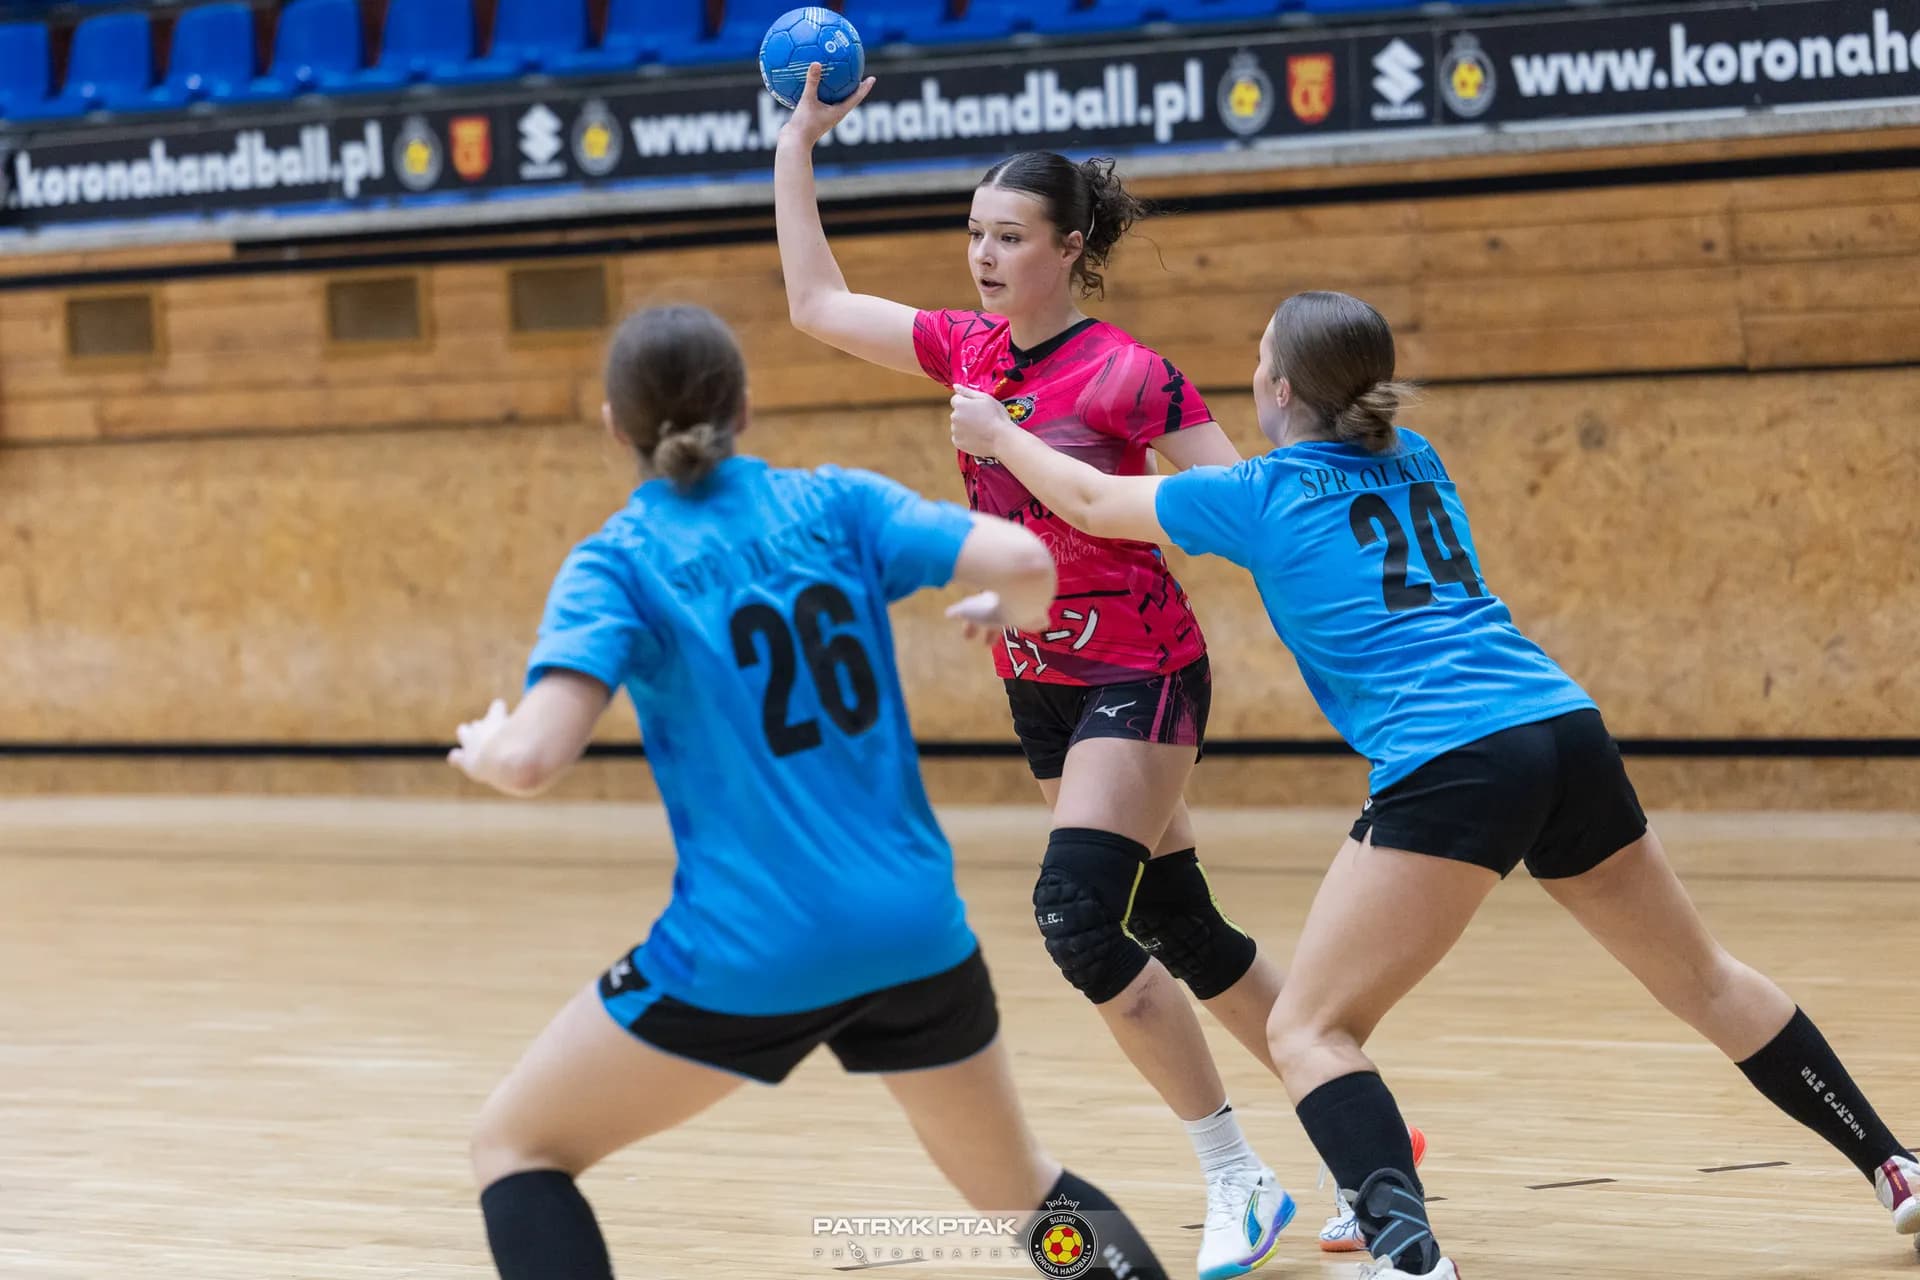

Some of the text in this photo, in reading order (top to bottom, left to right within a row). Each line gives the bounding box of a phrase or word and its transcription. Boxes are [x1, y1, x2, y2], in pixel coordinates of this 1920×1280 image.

[1511, 8, 1920, 97] www.koronah
[1299, 466, 1351, 499] SPR
[1349, 481, 1484, 614] 24
[729, 582, 880, 759] 26
[1801, 1066, 1867, 1140] SPR OLKUSZ
